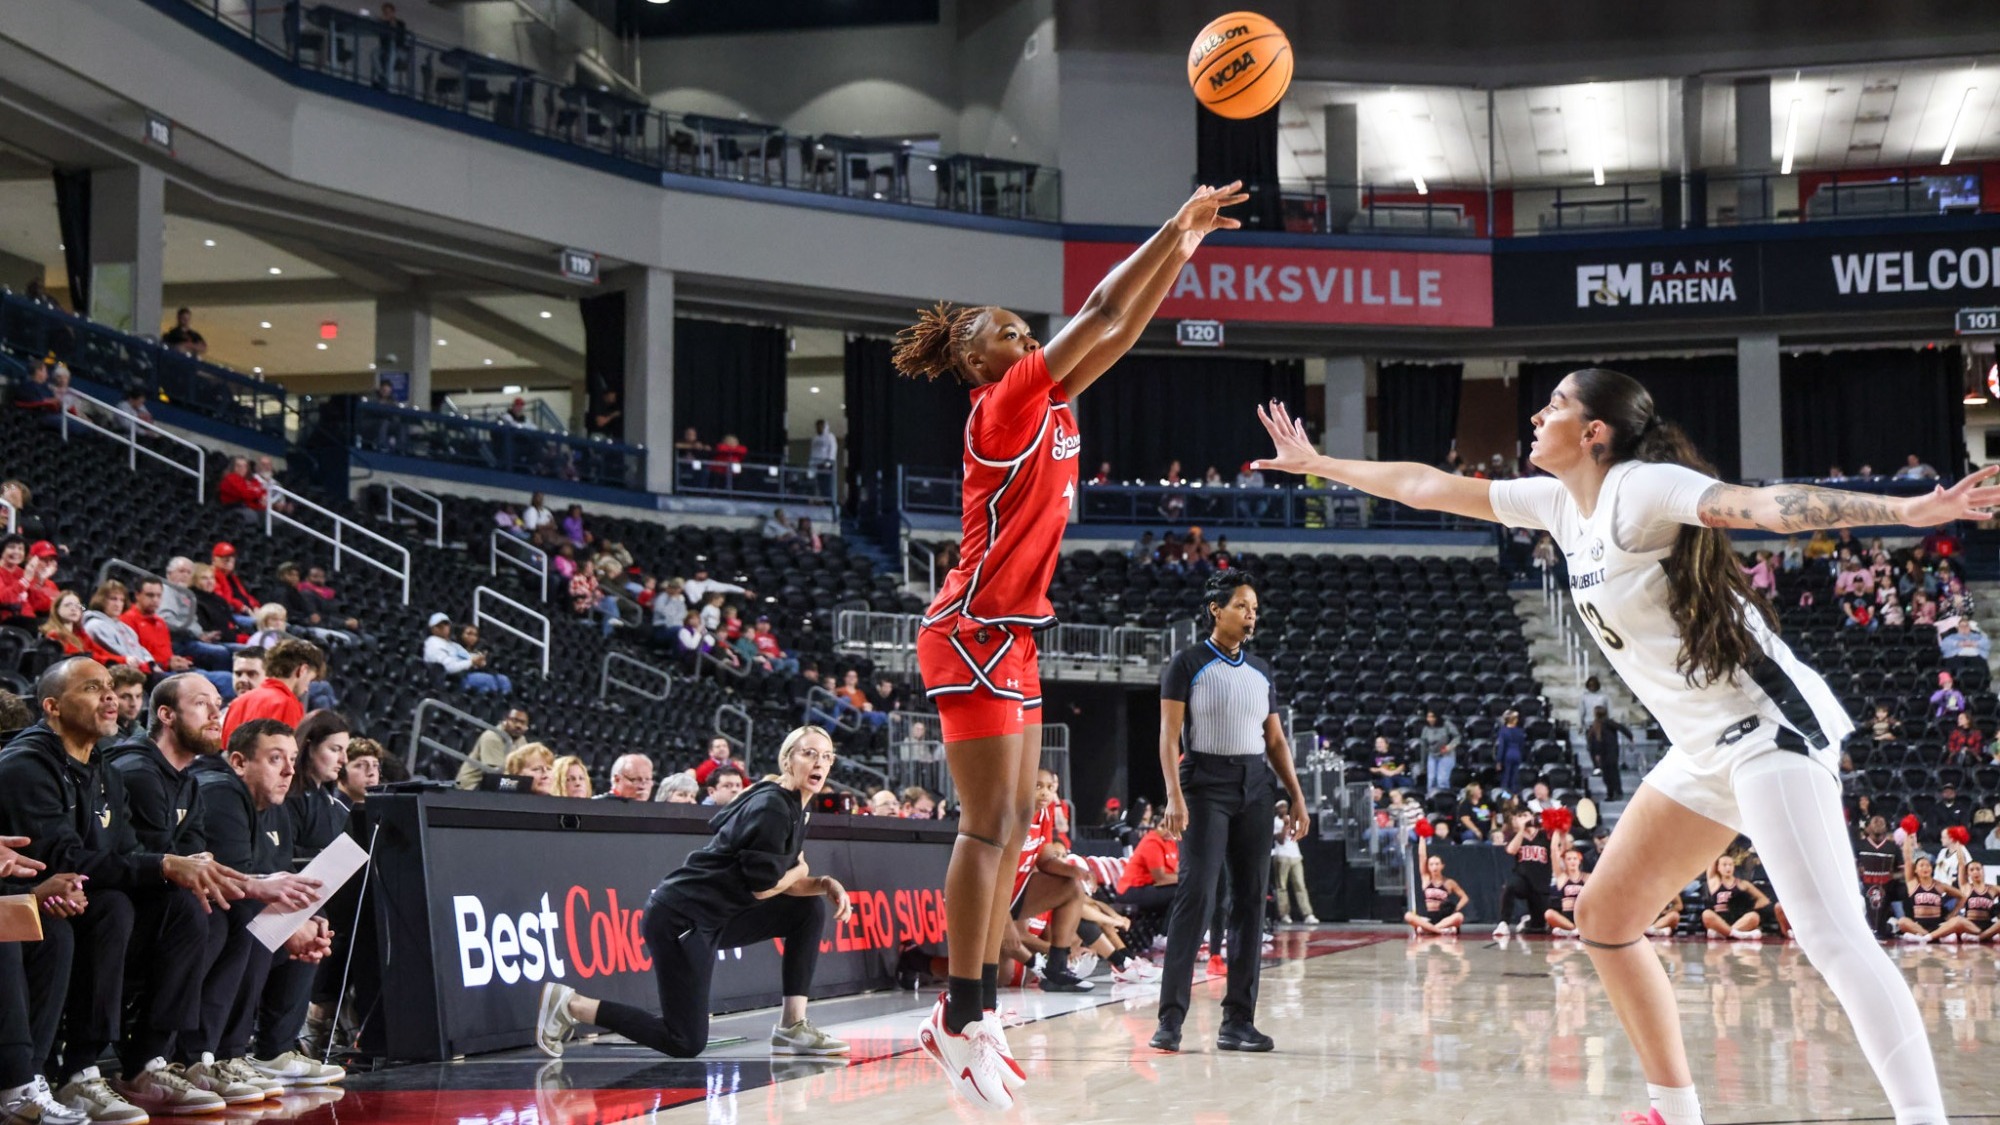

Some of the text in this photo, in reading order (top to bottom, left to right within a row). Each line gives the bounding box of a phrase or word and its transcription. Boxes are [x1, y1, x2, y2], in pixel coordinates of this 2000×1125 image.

[1208, 50, 1256, 91] NCAA
[1108, 260, 1443, 307] ARKSVILLE
[1650, 258, 1734, 276] BANK
[1831, 246, 2000, 295] WELCO
[1647, 276, 1738, 305] ARENA
[1186, 325, 1215, 341] 120
[1967, 312, 1997, 329] 101
[453, 885, 653, 987] Best Coke
[835, 889, 948, 952] ZERO SUGA
